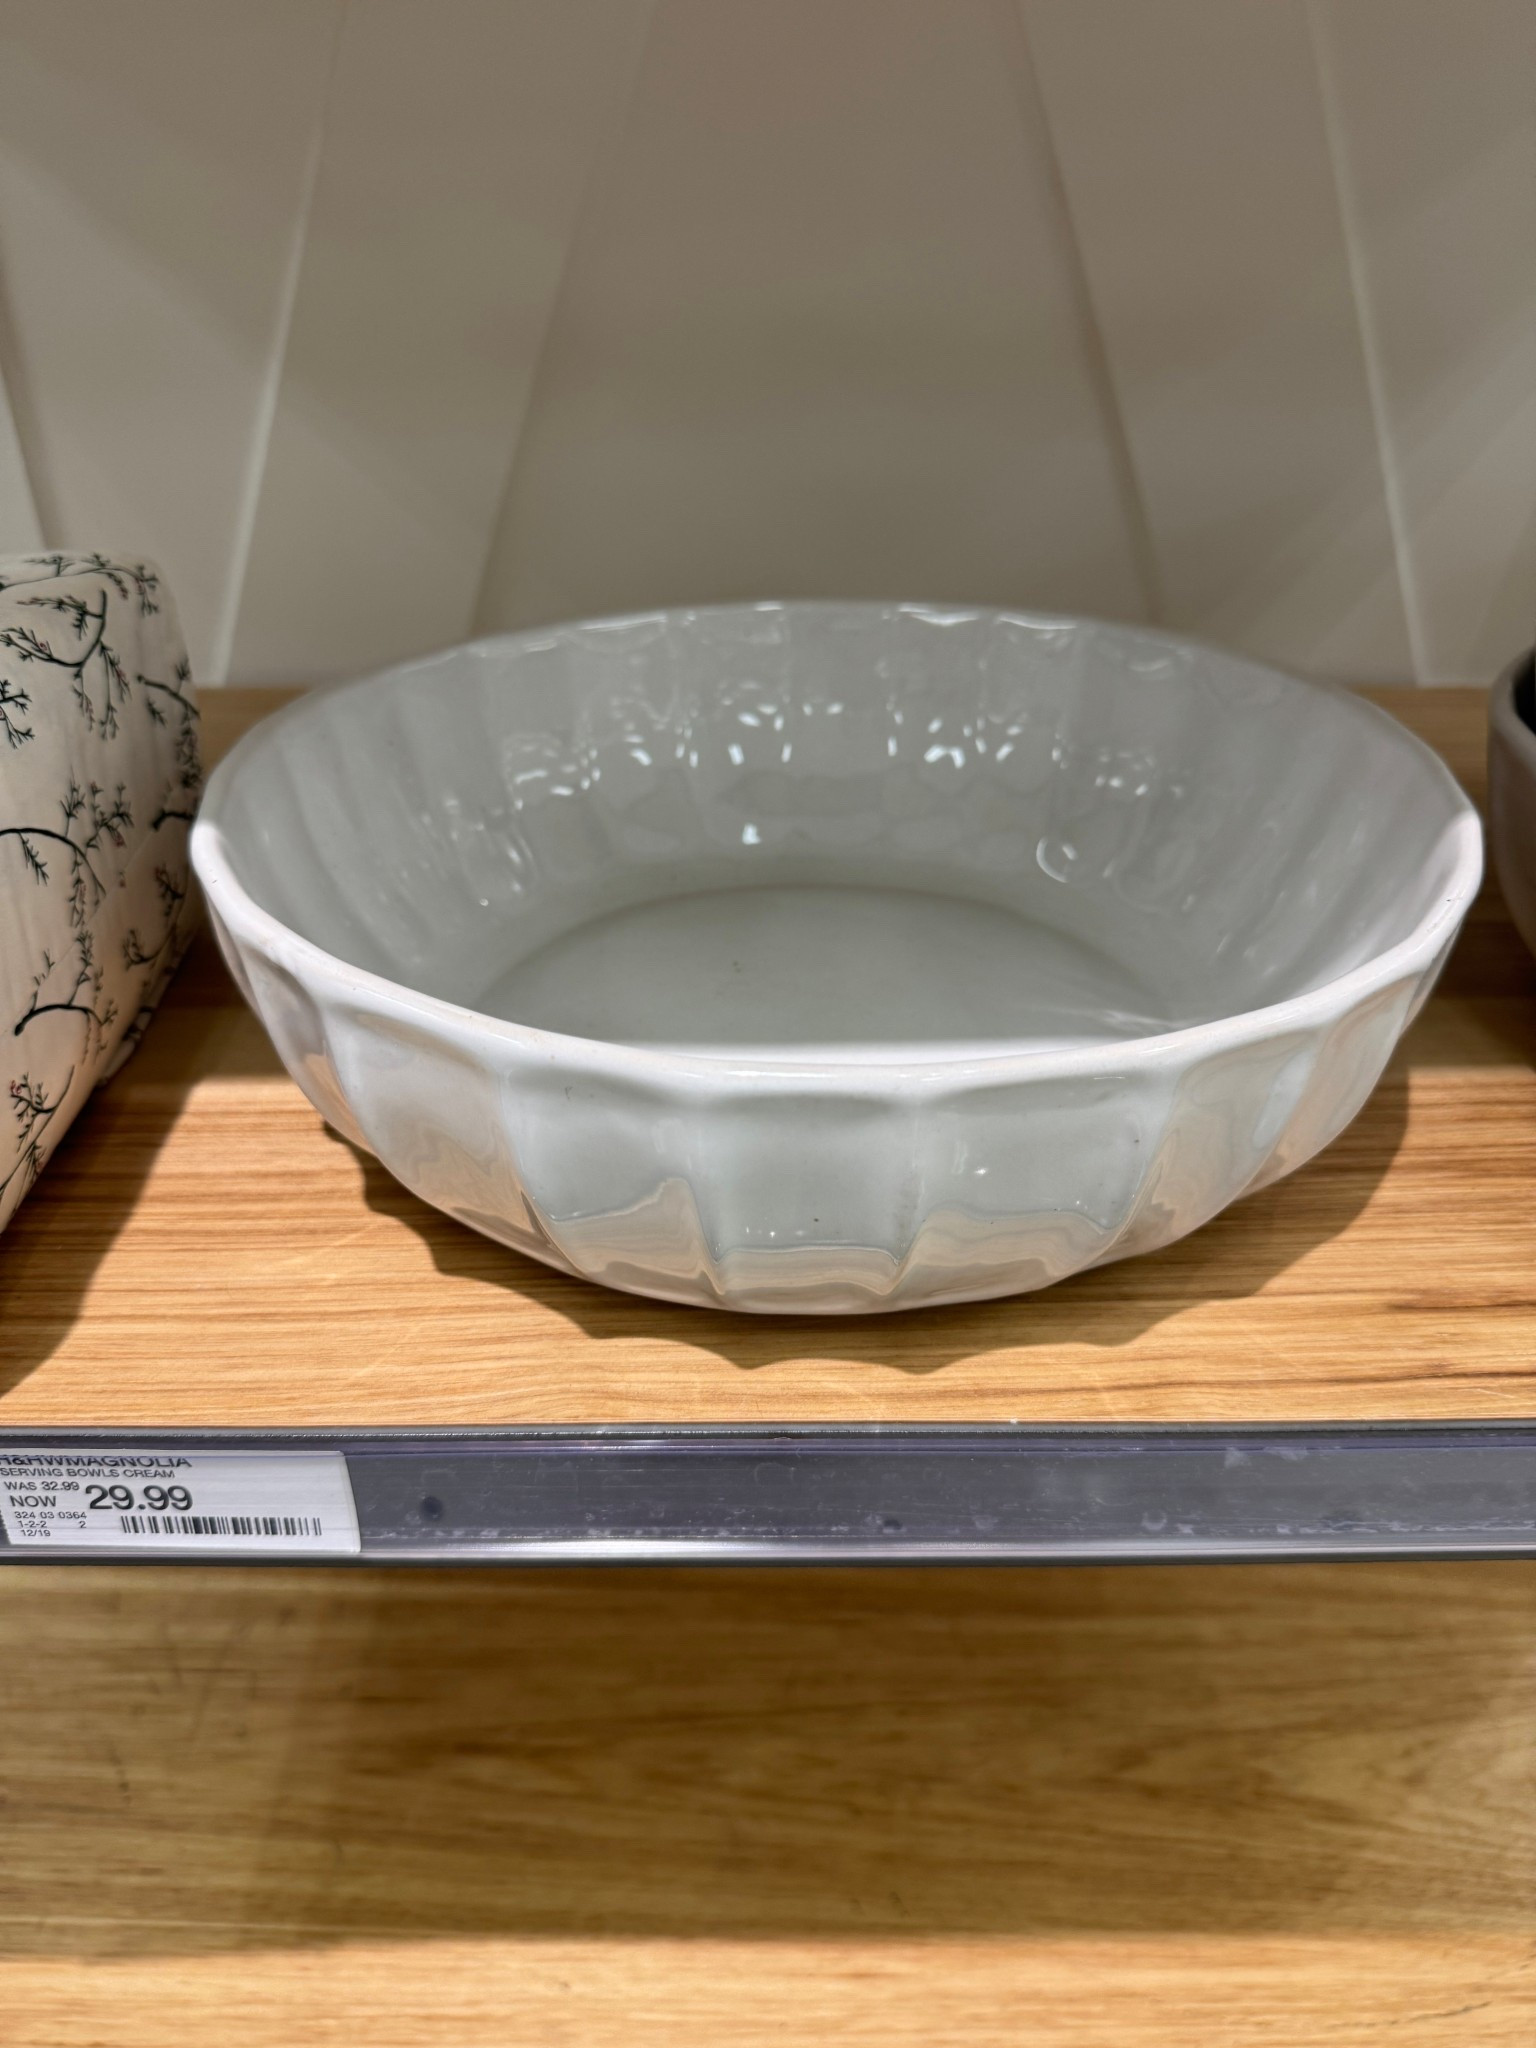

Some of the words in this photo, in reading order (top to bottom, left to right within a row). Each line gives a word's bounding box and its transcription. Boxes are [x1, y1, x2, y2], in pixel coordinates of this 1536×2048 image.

[0, 1467, 64, 1478] SERVING
[67, 1468, 120, 1478] BOWLS
[123, 1469, 175, 1479] CREAM
[4, 1481, 37, 1491] WAS
[41, 1481, 80, 1491] 32.99
[10, 1495, 57, 1508] NOW
[85, 1484, 193, 1511] 29.99
[14, 1511, 36, 1519] 324
[40, 1511, 55, 1519] 03
[58, 1511, 87, 1519] 0364
[18, 1520, 47, 1529] 1-2-2
[79, 1520, 87, 1529] 2
